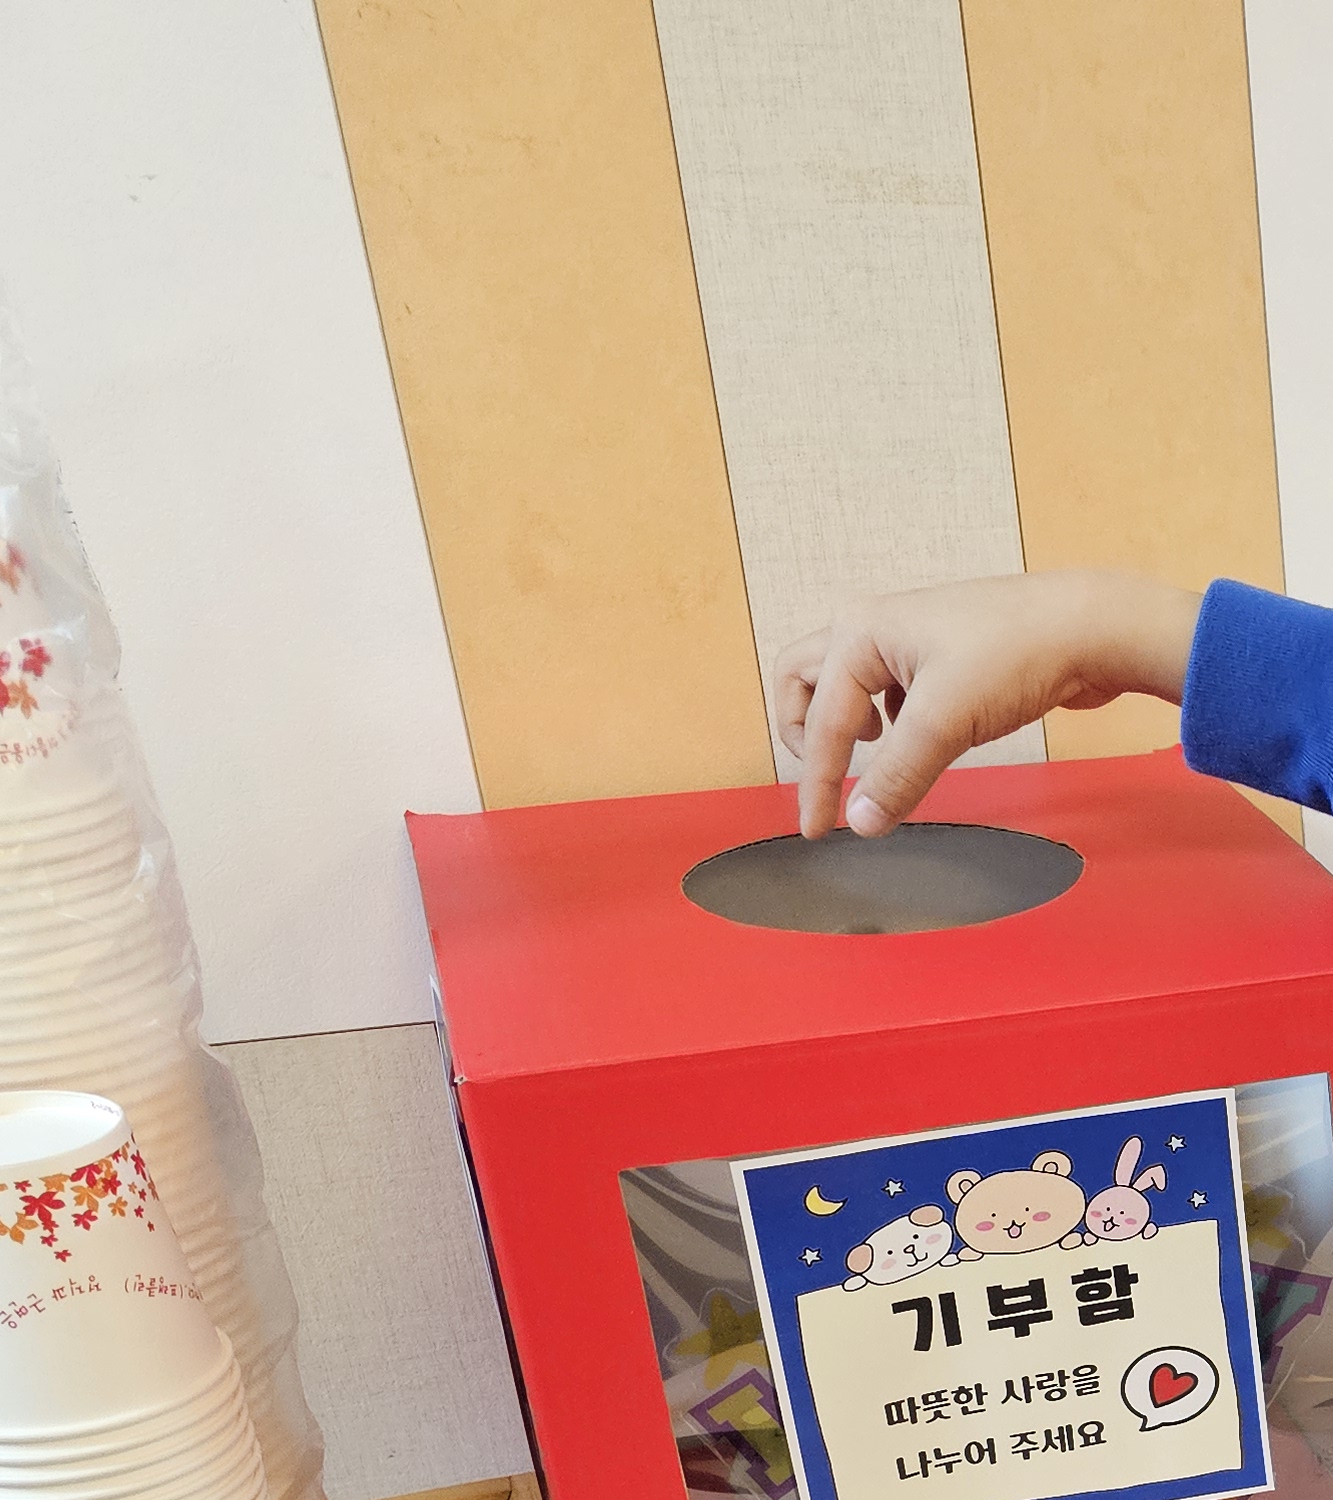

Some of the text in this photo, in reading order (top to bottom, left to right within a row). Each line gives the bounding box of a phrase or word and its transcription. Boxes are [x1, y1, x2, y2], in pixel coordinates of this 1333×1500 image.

[51, 1274, 102, 1302] 정직과
[891, 1263, 1139, 1352] 기부함
[883, 1364, 1100, 1426] 따뜻한 사랑을
[895, 1420, 1107, 1481] 나누어 주세요
